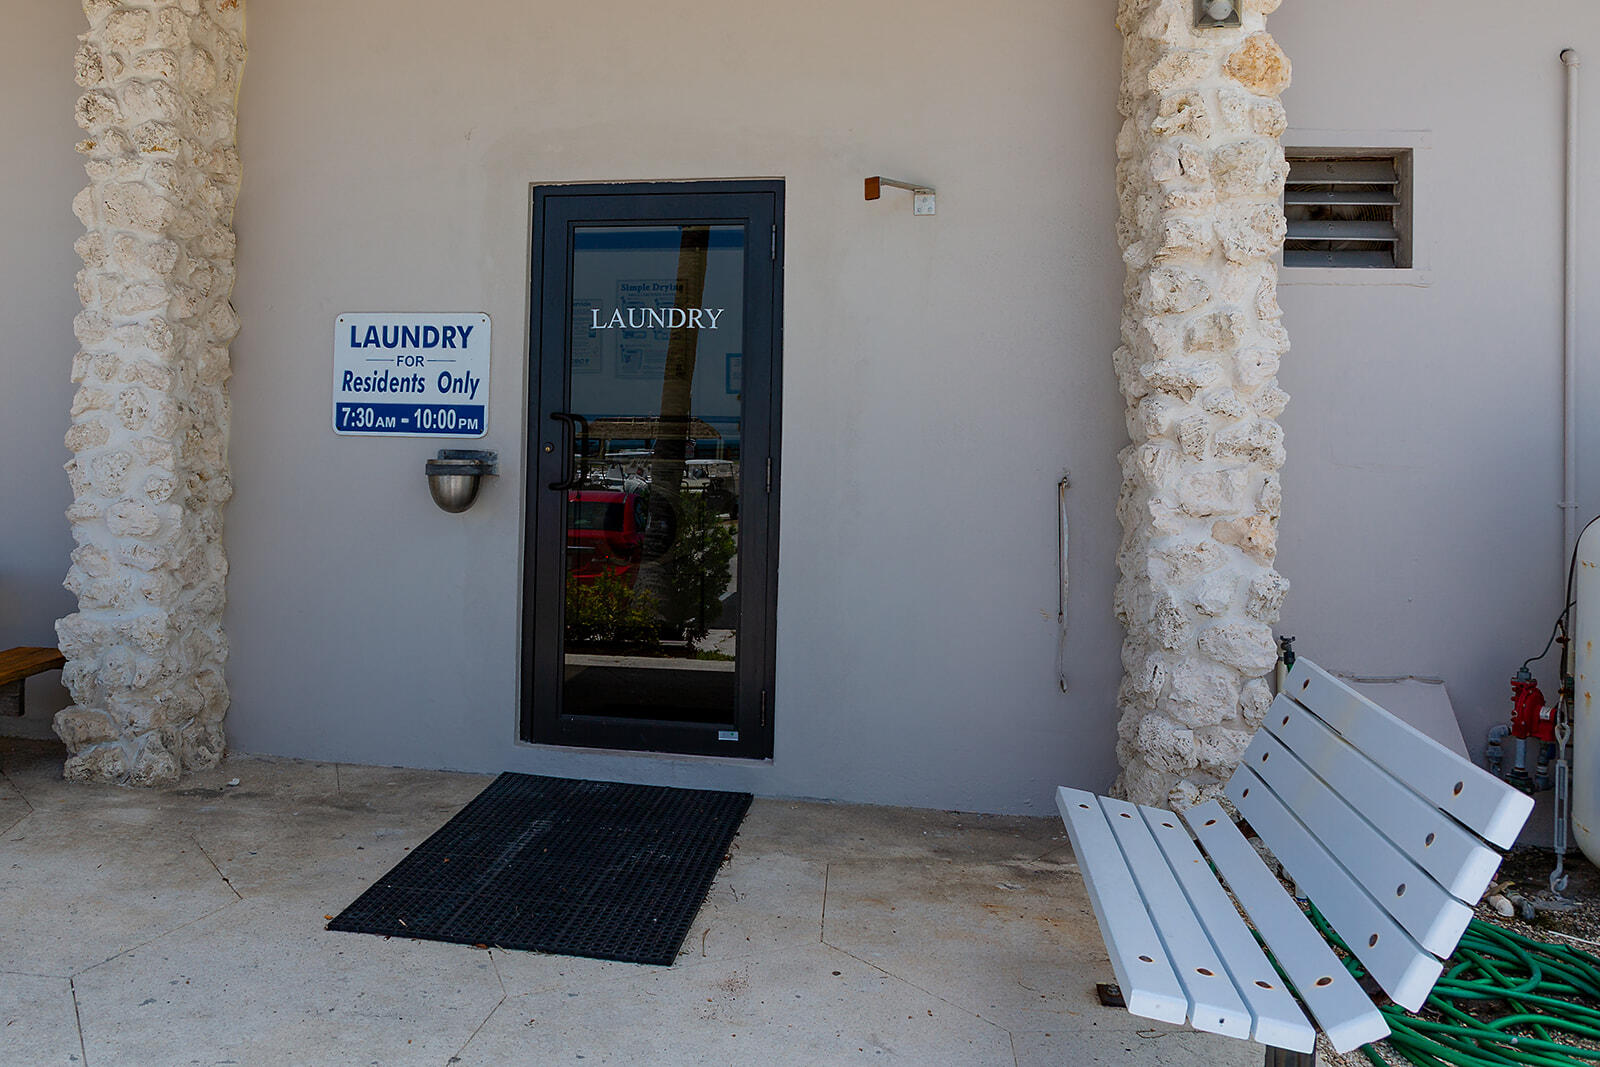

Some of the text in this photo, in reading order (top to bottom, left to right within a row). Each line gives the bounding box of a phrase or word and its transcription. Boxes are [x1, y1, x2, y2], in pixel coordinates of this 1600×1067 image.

[621, 283, 684, 293] Simple Drying
[591, 308, 725, 330] LAUNDRY
[350, 325, 474, 349] LAUNDRY
[396, 355, 425, 367] FOR
[342, 369, 480, 400] Residents Only
[413, 408, 456, 429] 10:00
[458, 418, 478, 430] PM
